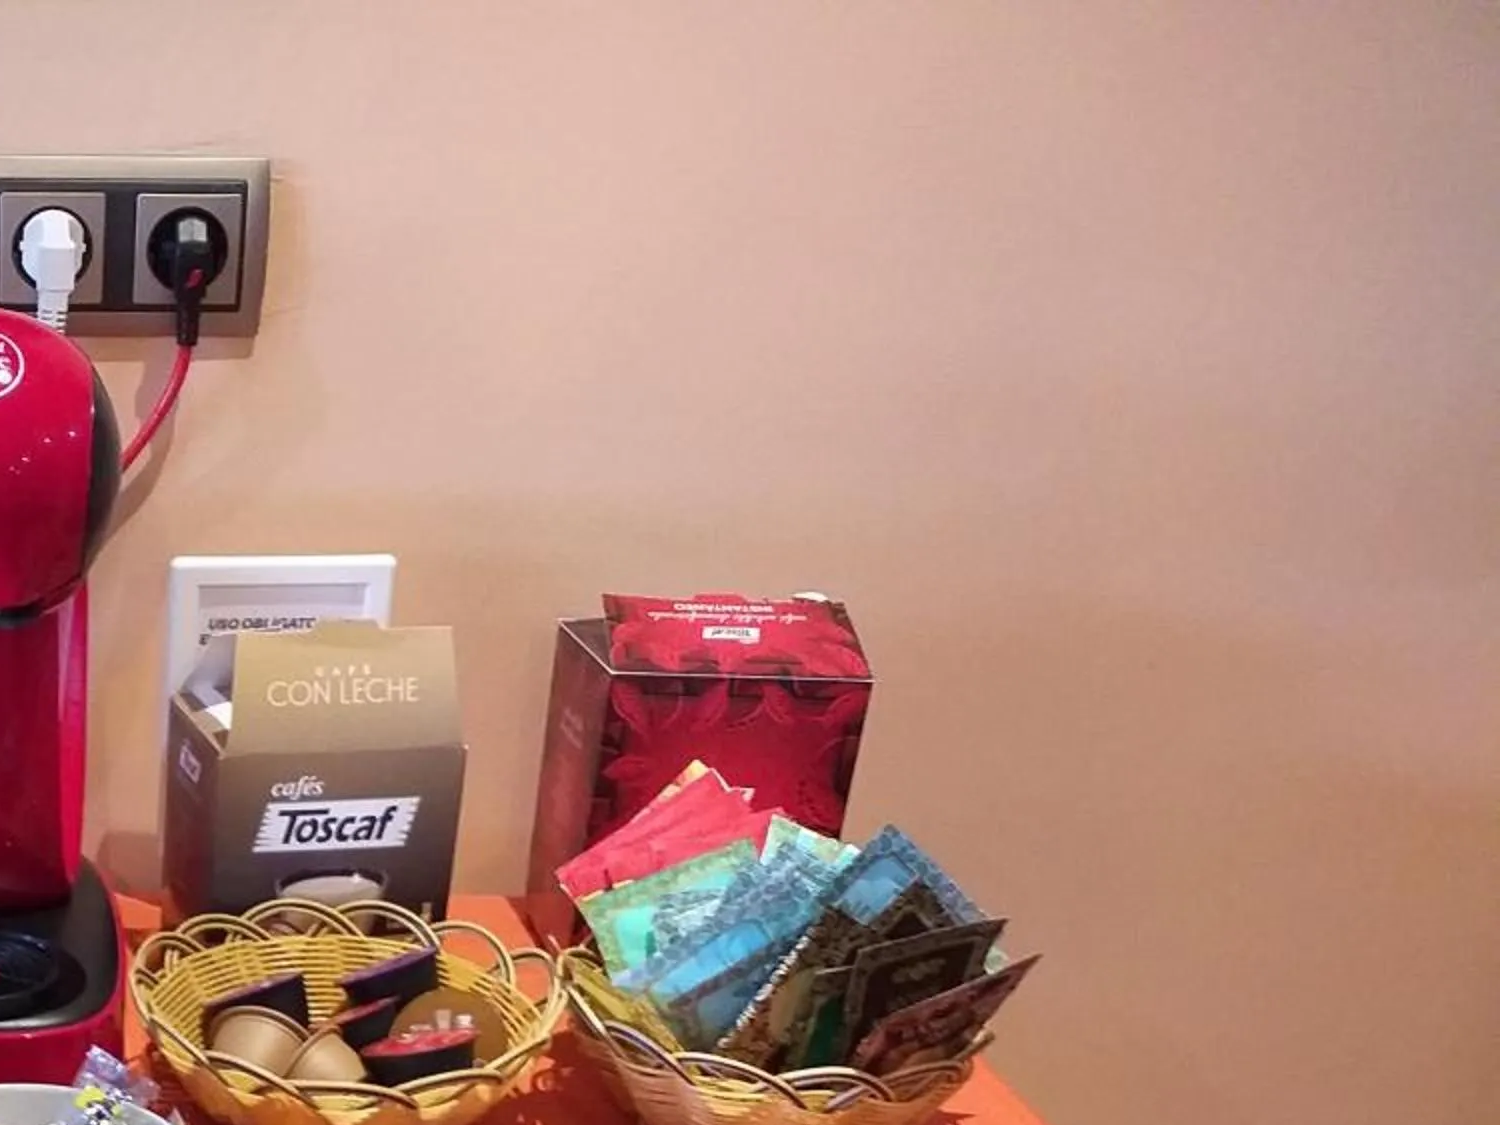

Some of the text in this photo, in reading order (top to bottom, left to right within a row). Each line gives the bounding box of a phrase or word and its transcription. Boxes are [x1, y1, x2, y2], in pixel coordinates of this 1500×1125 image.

[267, 677, 419, 707] CON LECHE
[270, 775, 325, 801] cafés
[278, 806, 398, 844] Toscaf
